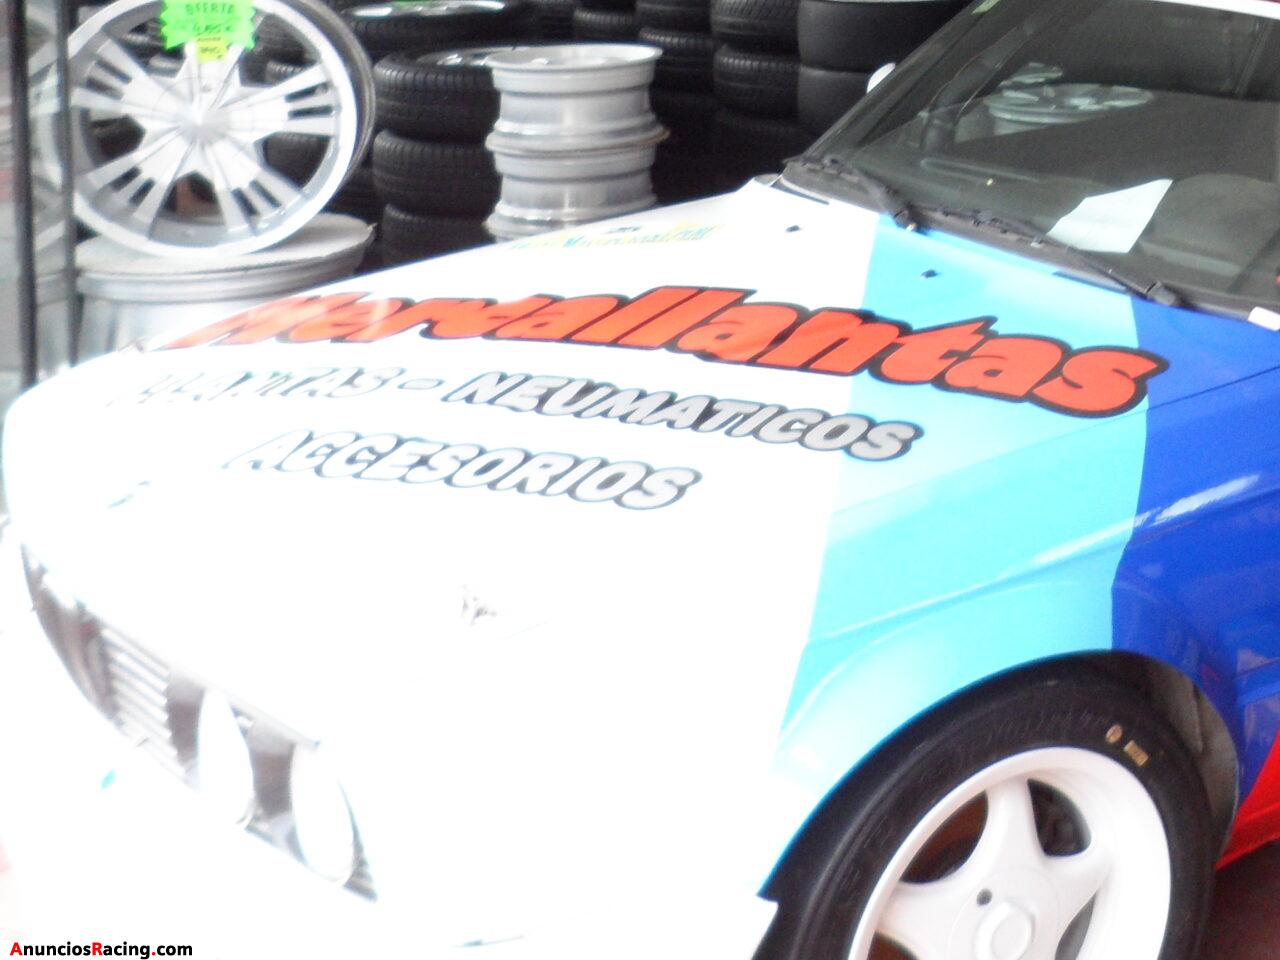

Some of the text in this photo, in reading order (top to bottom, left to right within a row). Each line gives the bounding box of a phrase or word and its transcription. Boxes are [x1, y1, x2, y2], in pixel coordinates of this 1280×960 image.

[152, 286, 1170, 418] Mercallantas
[441, 370, 924, 461] NEUMATICOS
[220, 429, 703, 511] ACCESORIOS
